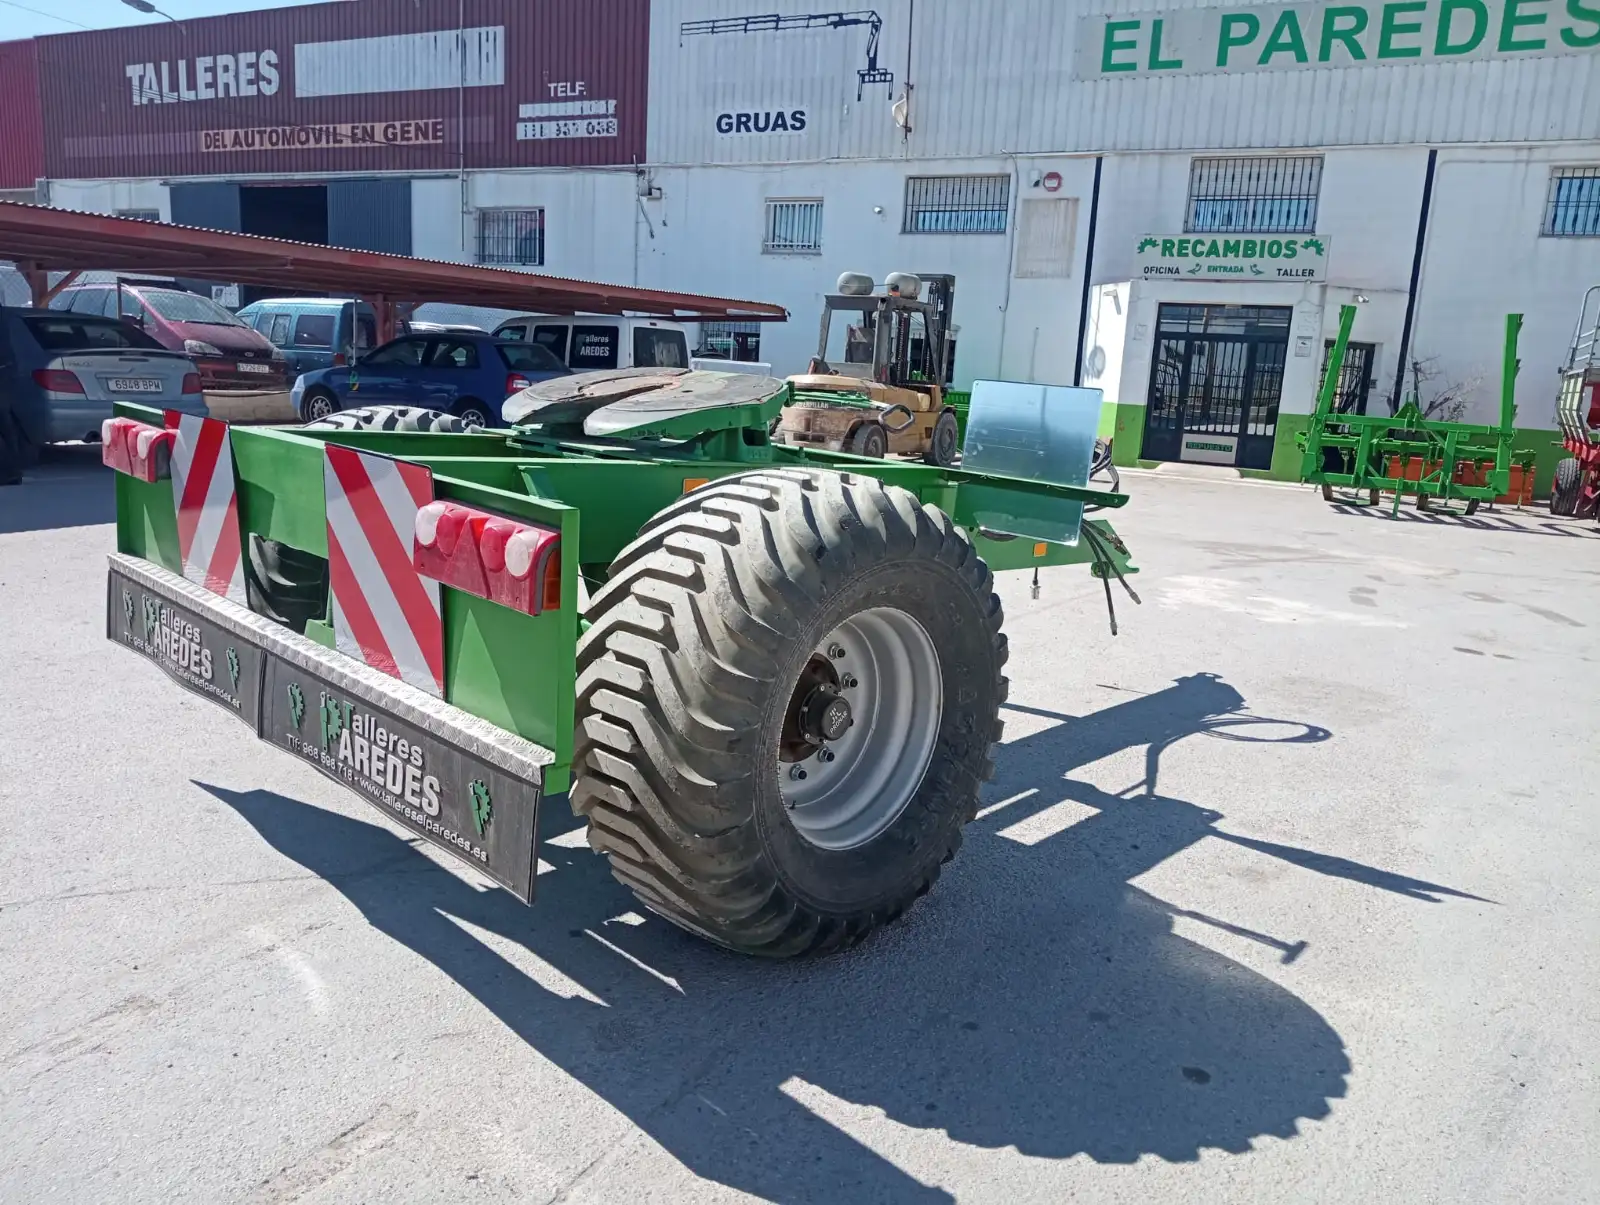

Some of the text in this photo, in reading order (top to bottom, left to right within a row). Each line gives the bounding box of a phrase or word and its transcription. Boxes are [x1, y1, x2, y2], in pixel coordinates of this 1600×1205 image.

[1101, 0, 1600, 73] EL PAREDES
[126, 49, 279, 106] TALLERES
[548, 81, 587, 97] TELF.
[203, 120, 443, 150] DEL AUTOMOVIL EN GENE
[716, 110, 806, 134] GRUAS
[1161, 239, 1298, 259] RECAMBIOS
[1143, 265, 1315, 277] OFICINA ENTRADA TALLER
[115, 379, 140, 390] 6948
[343, 700, 423, 767] Talleres
[360, 777, 487, 862] www.tallereselparedes.es
